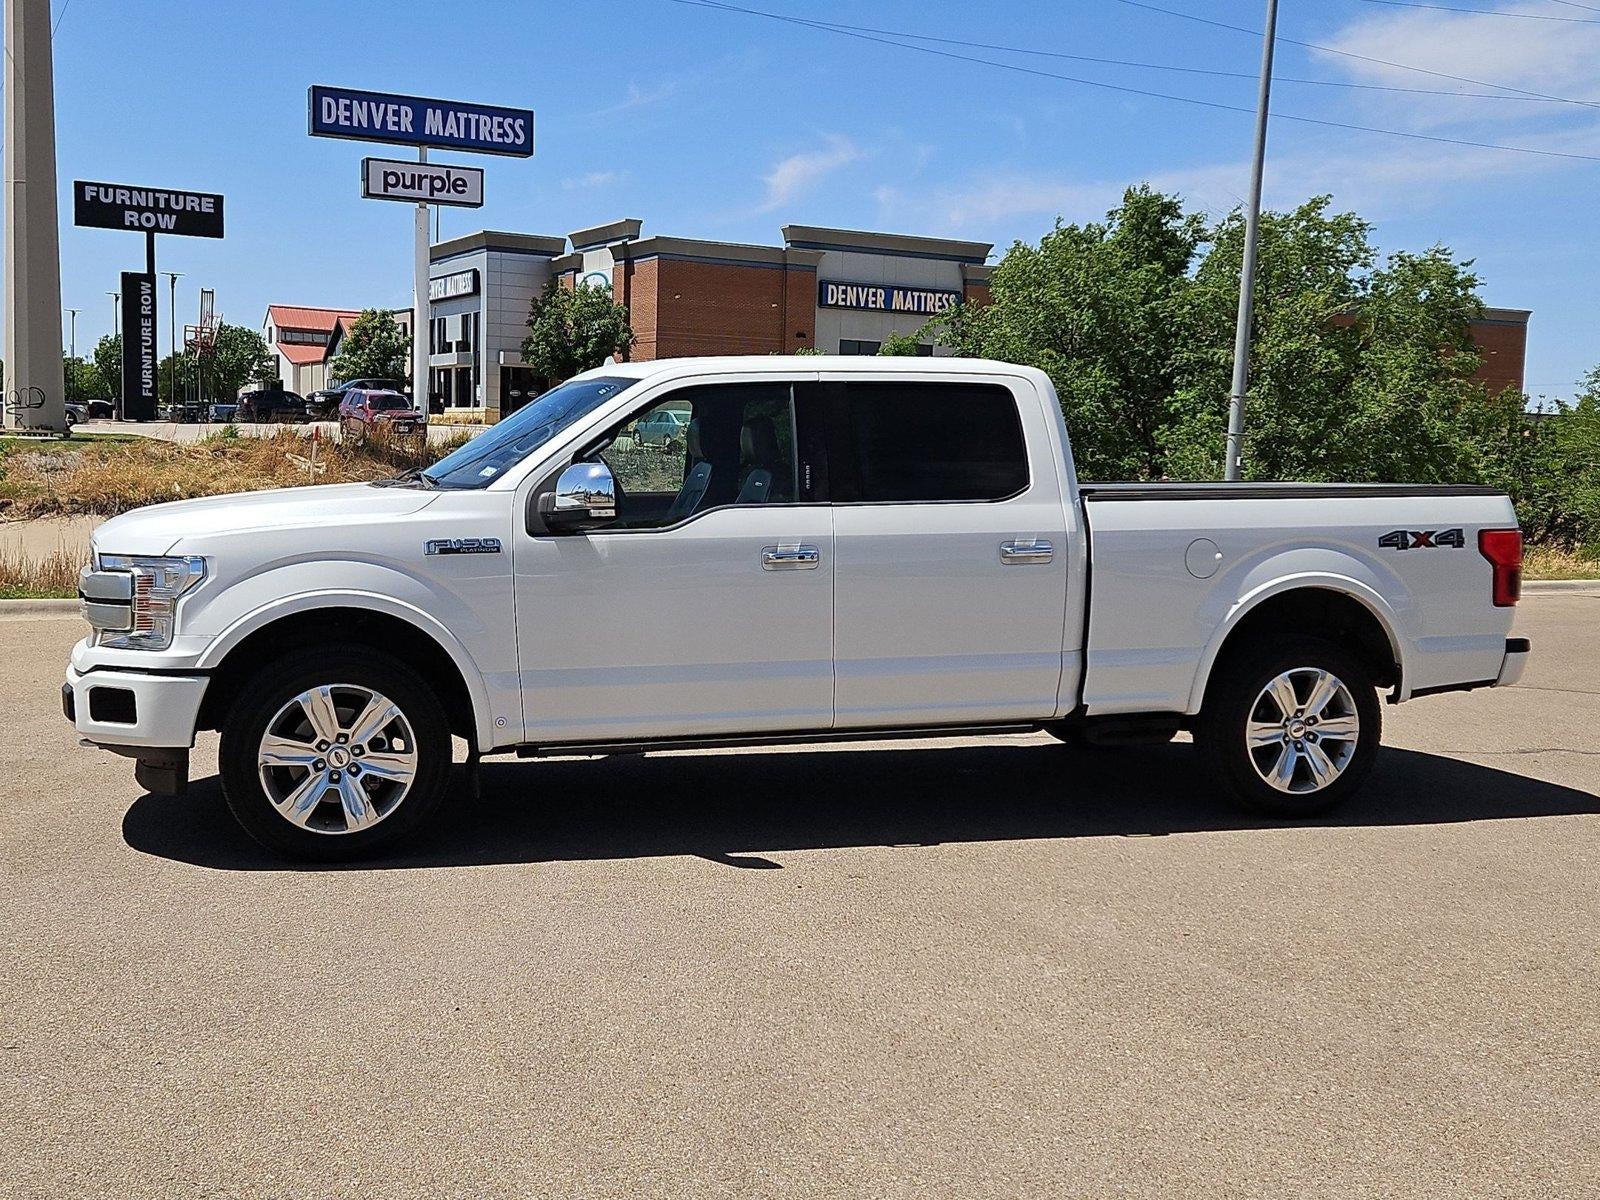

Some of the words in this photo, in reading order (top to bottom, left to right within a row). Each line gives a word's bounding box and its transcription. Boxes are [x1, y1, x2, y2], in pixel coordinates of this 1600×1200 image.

[322, 97, 413, 133] DENVER
[424, 108, 525, 145] MATTRESS
[382, 169, 468, 197] purple
[84, 185, 215, 213] FURNITURE
[124, 210, 177, 230] ROW
[140, 281, 152, 314] ROW
[827, 284, 885, 308] DENVER
[141, 317, 153, 397] FURNITURE
